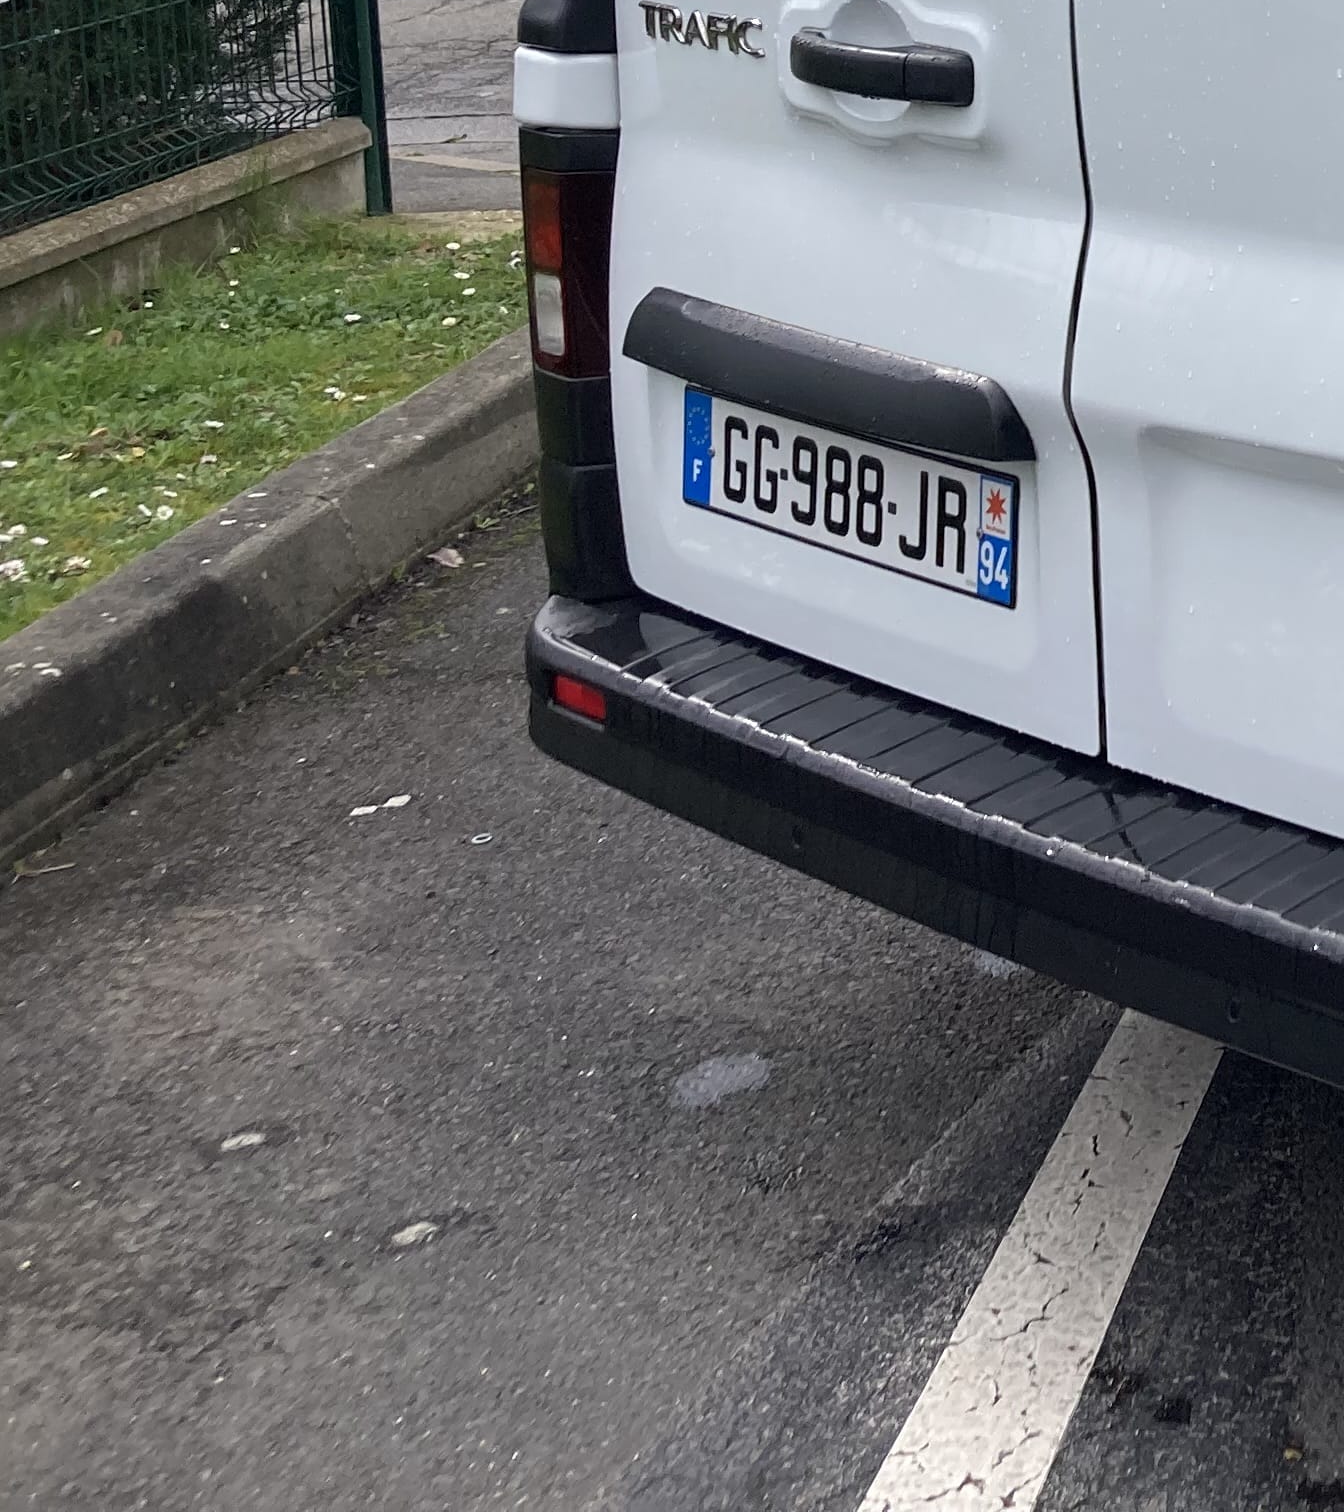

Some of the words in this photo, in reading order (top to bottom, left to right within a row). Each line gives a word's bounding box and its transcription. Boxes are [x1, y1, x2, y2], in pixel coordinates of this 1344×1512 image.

[638, 0, 766, 59] TRAFIC
[723, 415, 967, 574] GG-988-JR
[979, 540, 1009, 590] 94
